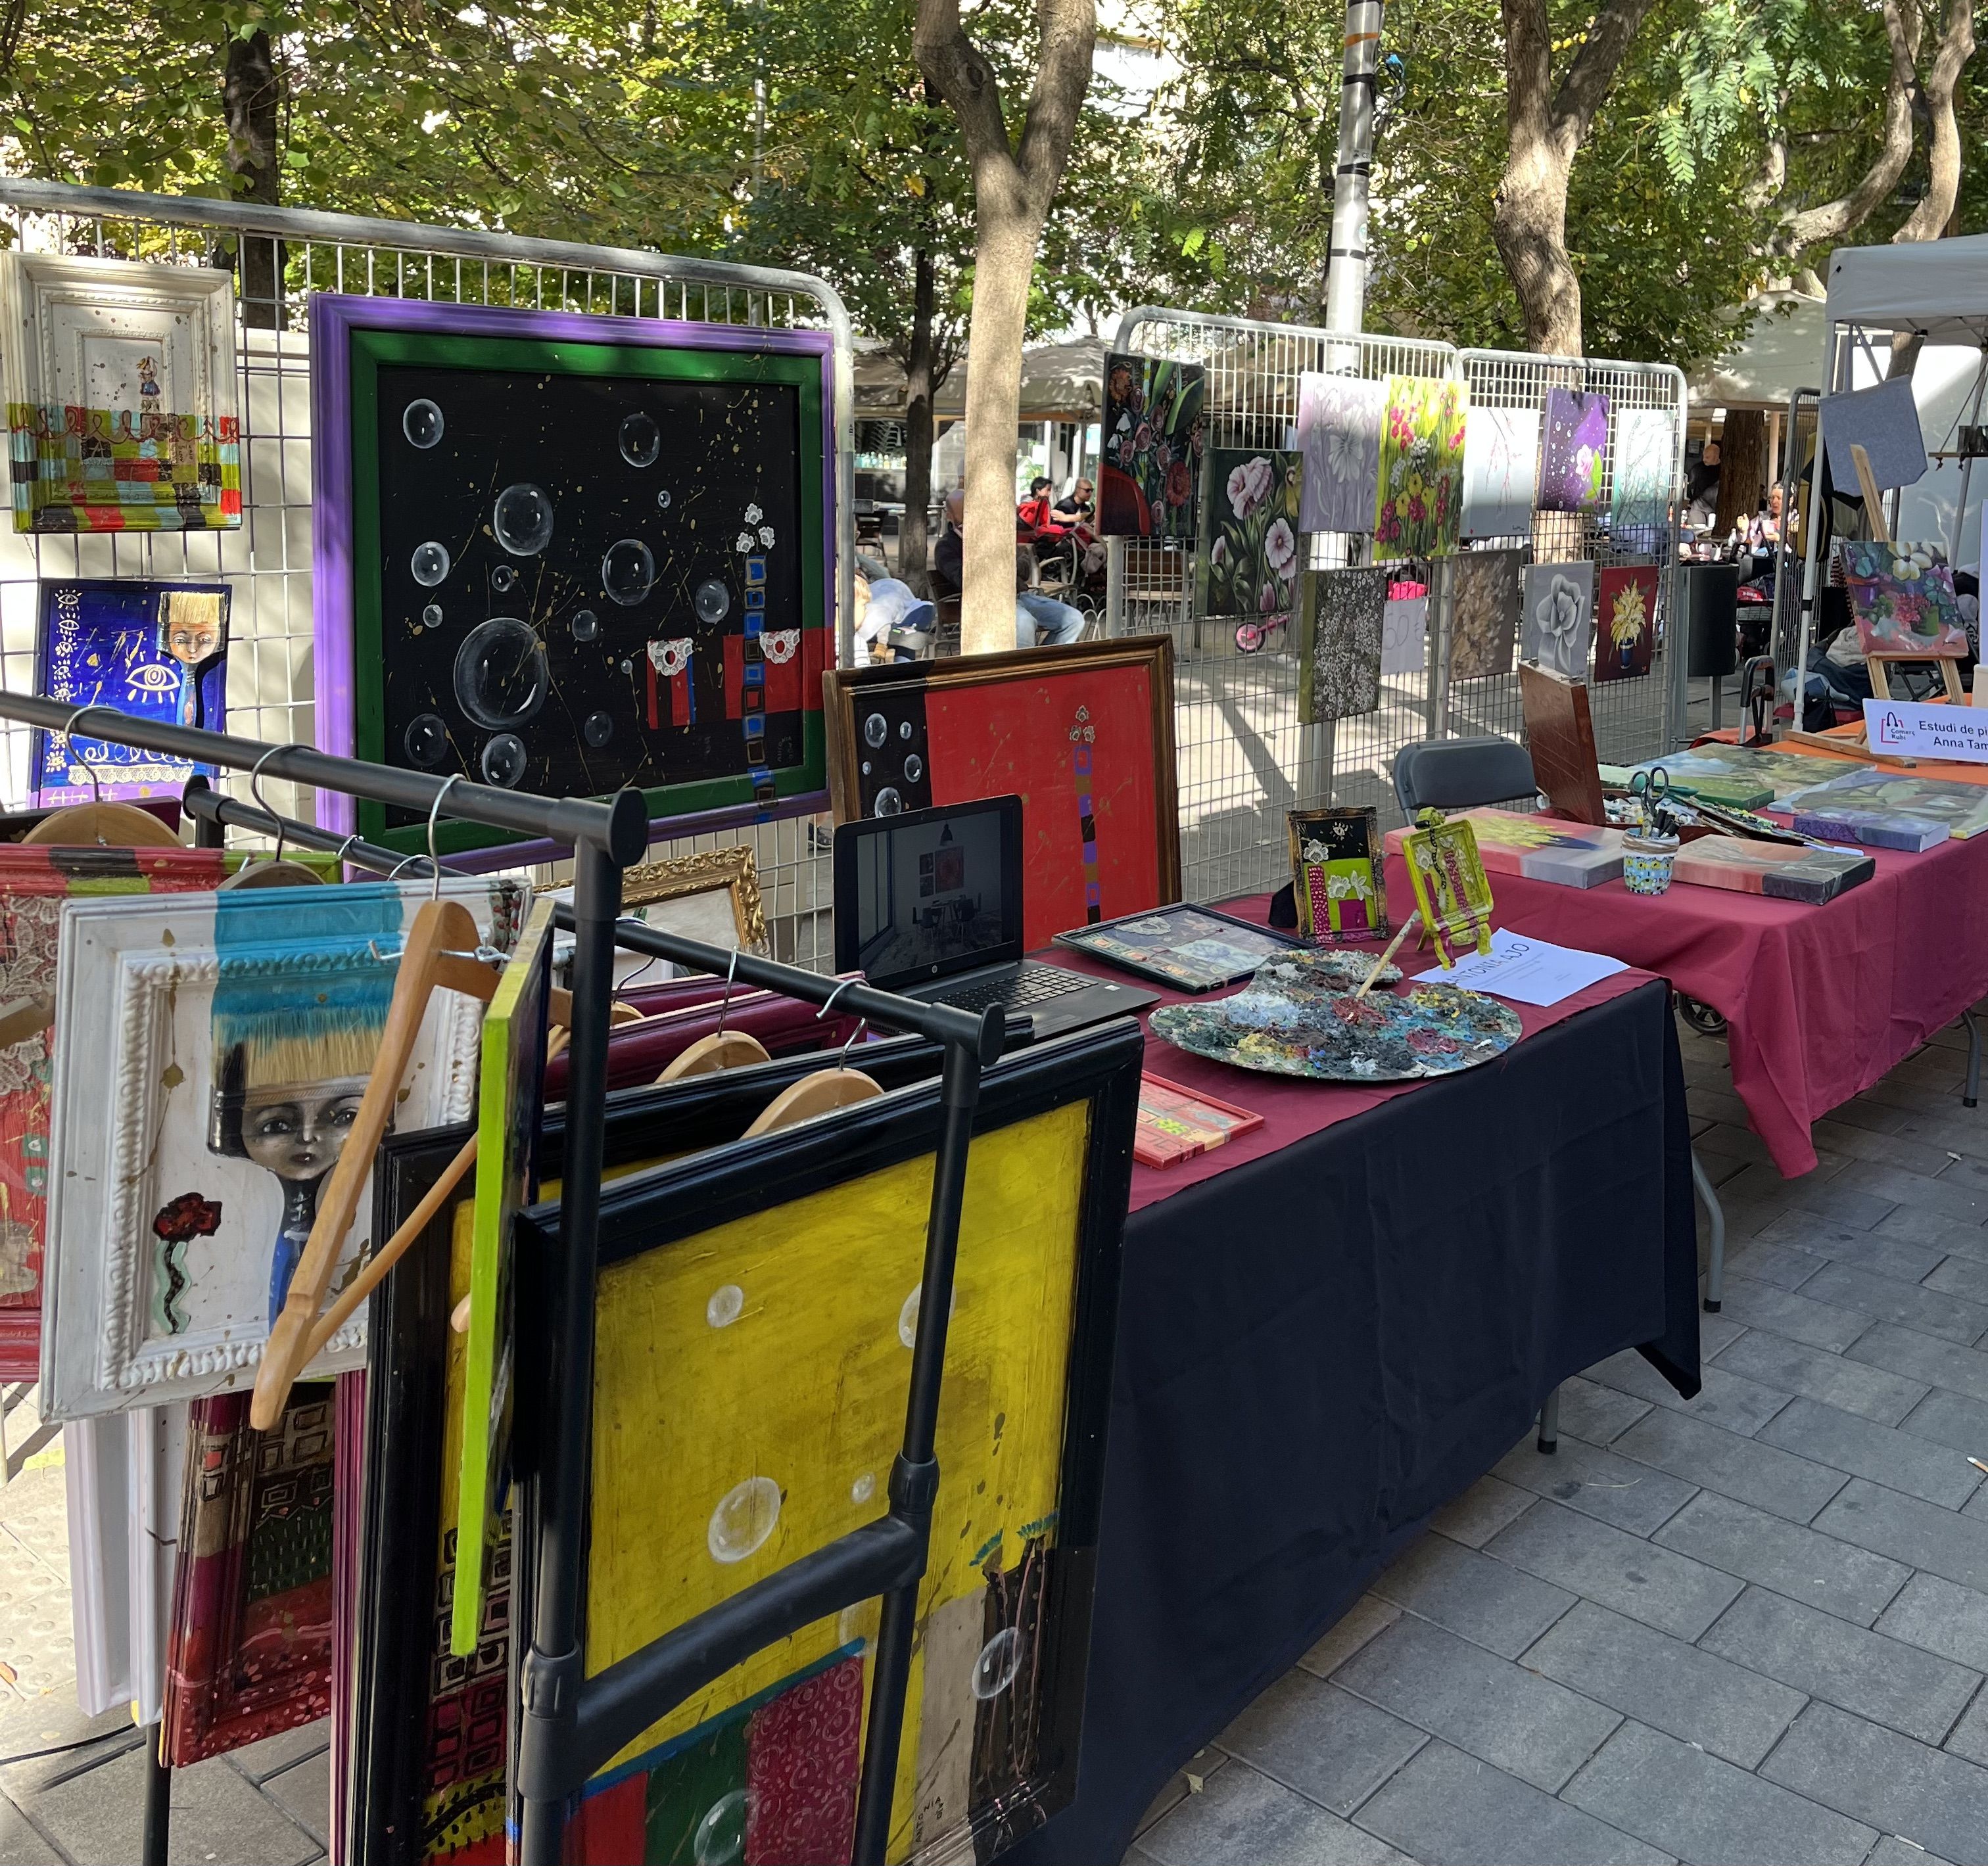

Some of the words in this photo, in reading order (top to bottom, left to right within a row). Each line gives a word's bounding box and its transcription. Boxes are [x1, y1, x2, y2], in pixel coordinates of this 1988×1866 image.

[1383, 613, 1409, 650] 50
[1919, 720, 1956, 733] Estudi
[1960, 724, 1974, 735] de
[1933, 736, 1964, 748] Anna
[1446, 960, 1509, 985] ANTONIA
[1500, 943, 1530, 960] AJO
